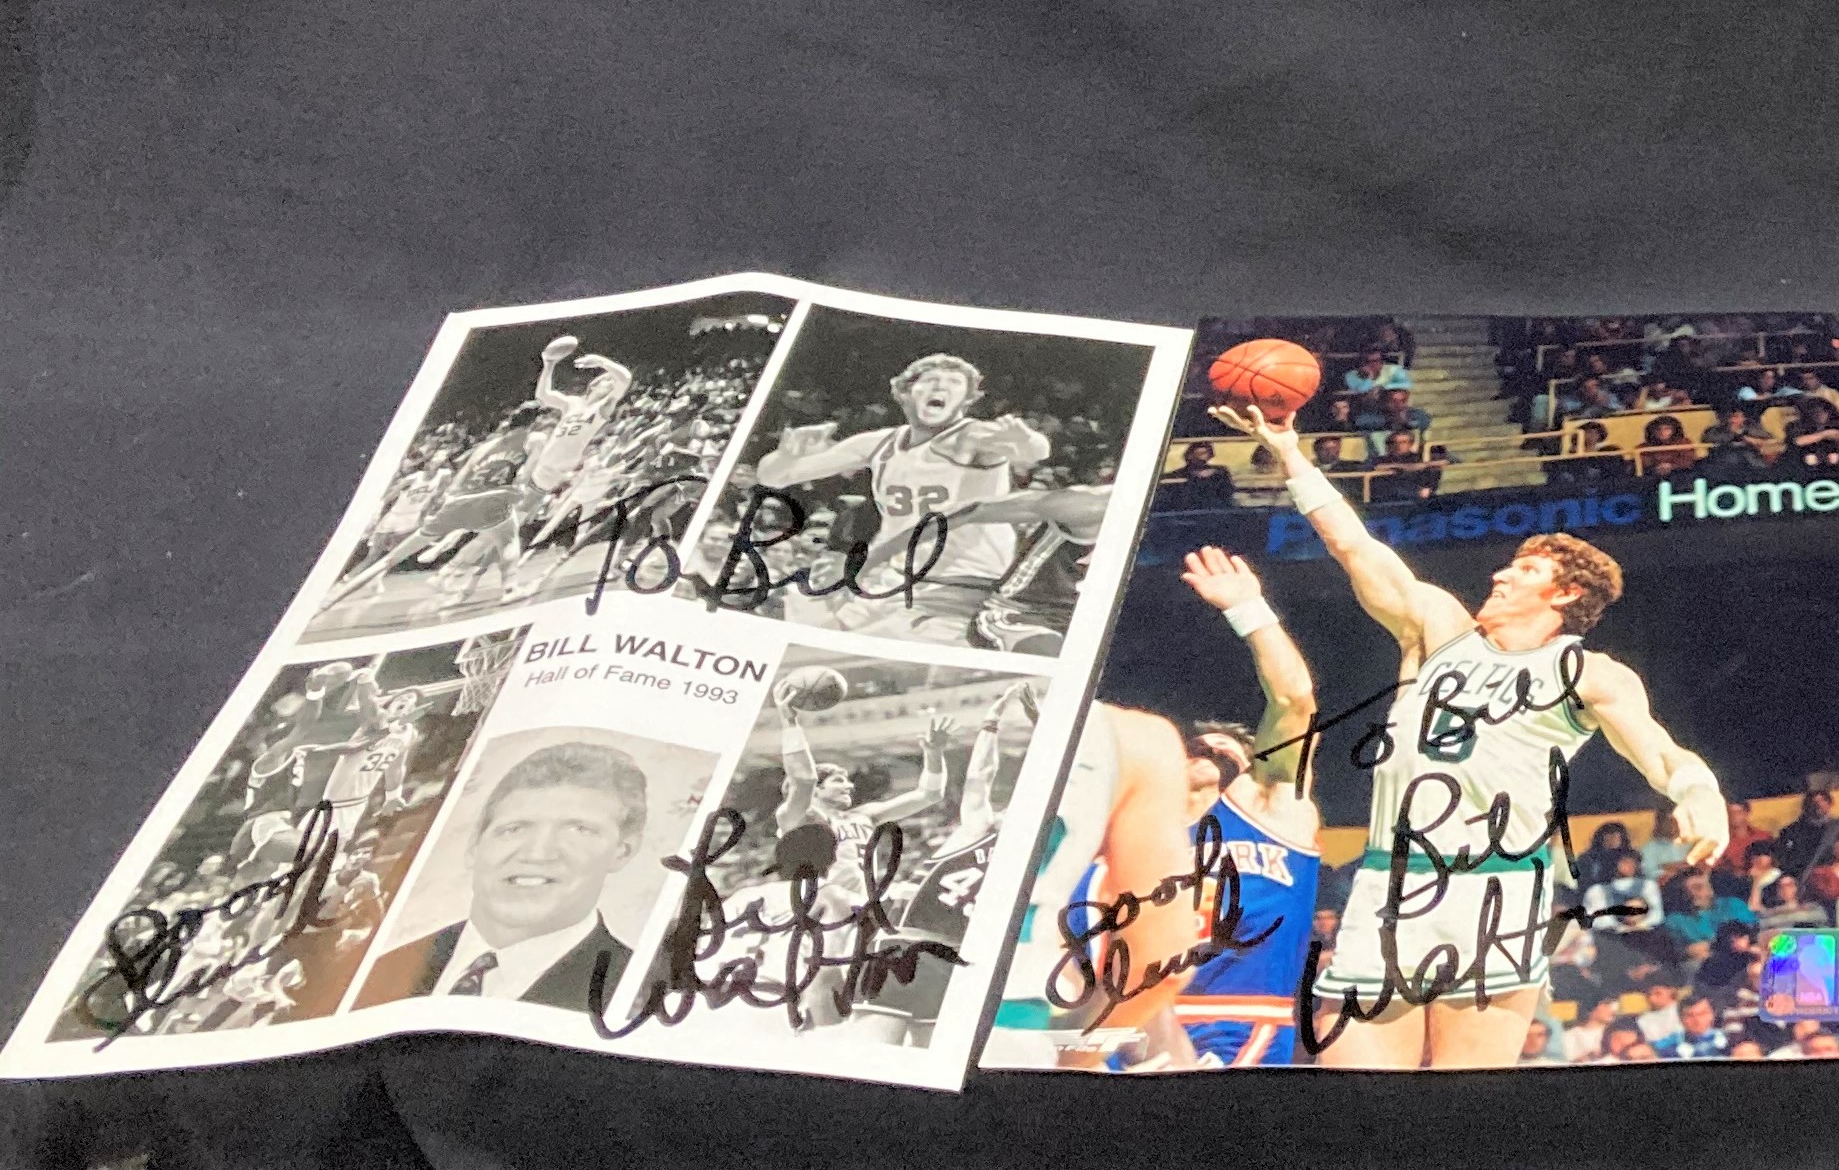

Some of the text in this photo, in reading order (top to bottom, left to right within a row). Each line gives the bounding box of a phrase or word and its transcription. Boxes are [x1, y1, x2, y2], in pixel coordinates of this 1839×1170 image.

[886, 485, 949, 517] 32
[1265, 489, 1642, 558] Pnasonic
[524, 633, 768, 682] BILL WALTON
[524, 663, 739, 705] Hall of Fame 1993
